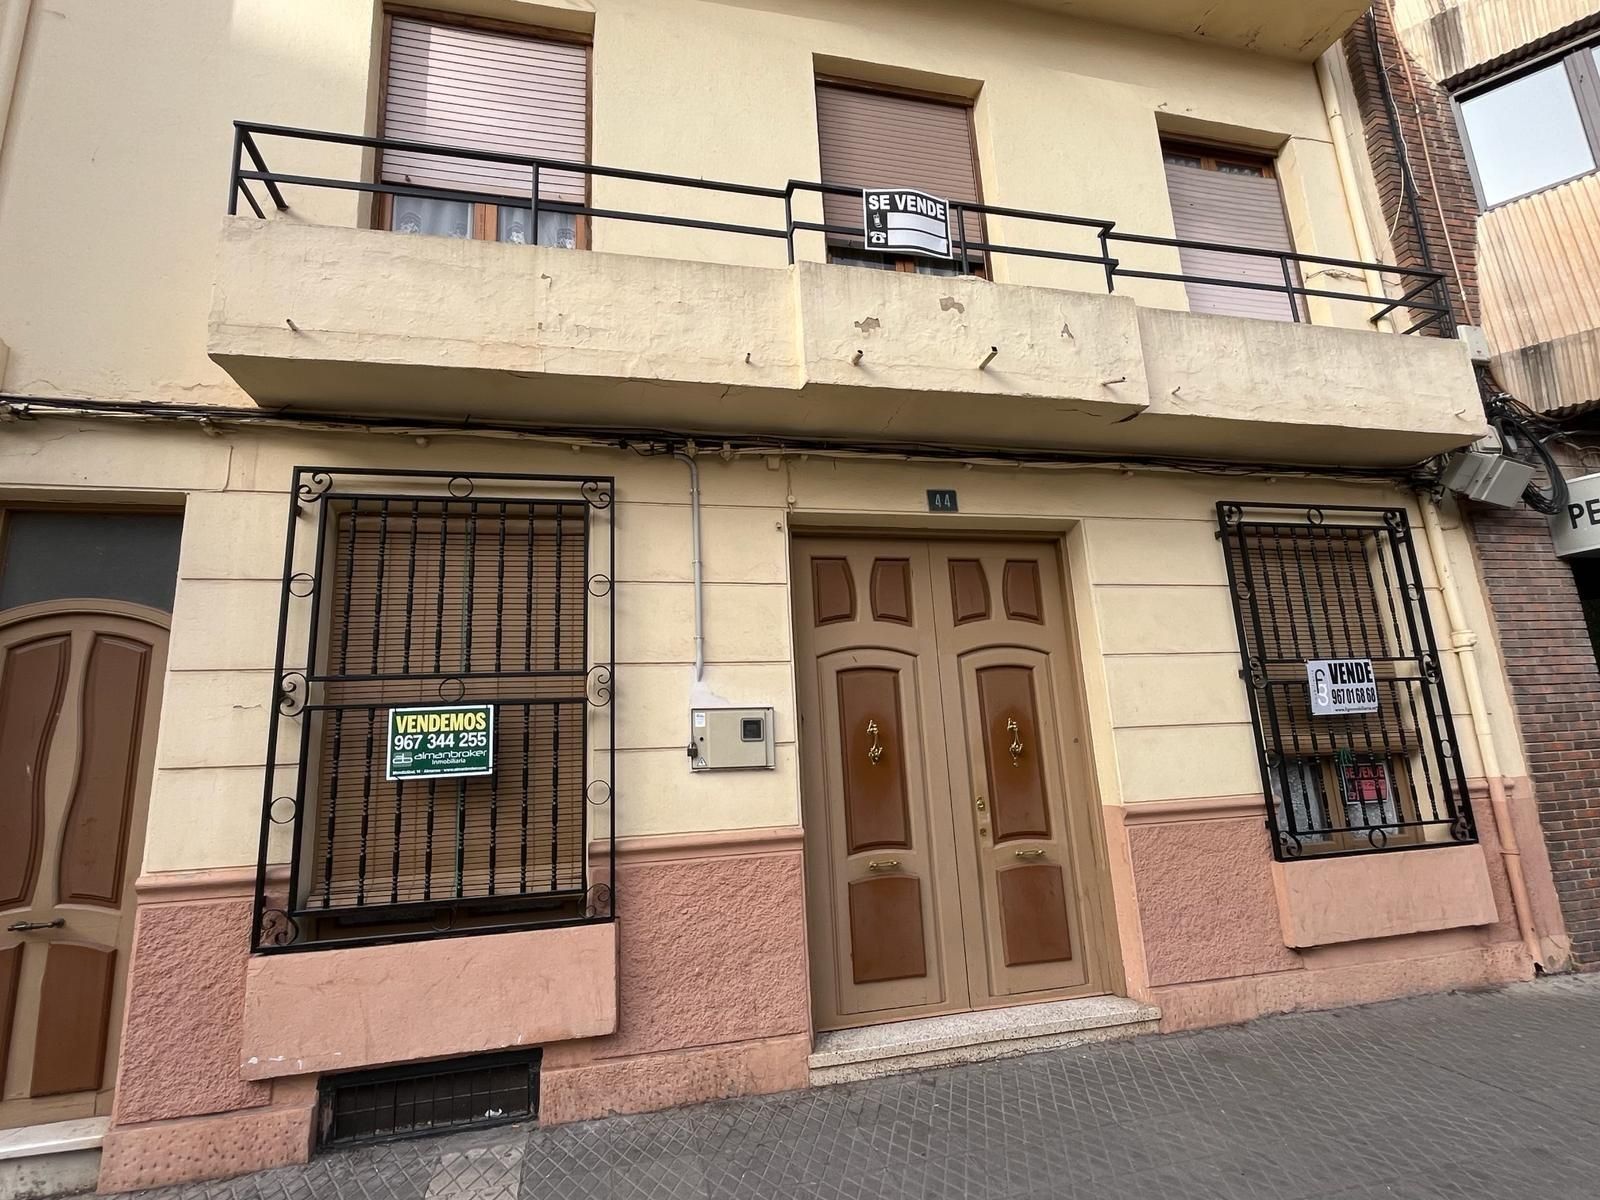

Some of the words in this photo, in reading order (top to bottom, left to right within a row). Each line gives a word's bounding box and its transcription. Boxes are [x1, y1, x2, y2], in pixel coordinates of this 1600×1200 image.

[868, 194, 891, 210] SE
[894, 194, 946, 220] VENDE
[935, 493, 951, 508] 44
[1567, 498, 1600, 530] PE
[1328, 662, 1373, 685] VENDE
[1331, 688, 1345, 705] 967
[1346, 687, 1355, 704] 01
[1355, 687, 1366, 703] 68
[1365, 686, 1376, 703] 68
[396, 712, 486, 733] VENDEMOS
[394, 735, 423, 750] 967
[427, 733, 455, 748] 344
[458, 731, 487, 747] 255
[414, 749, 487, 760] almanbroker
